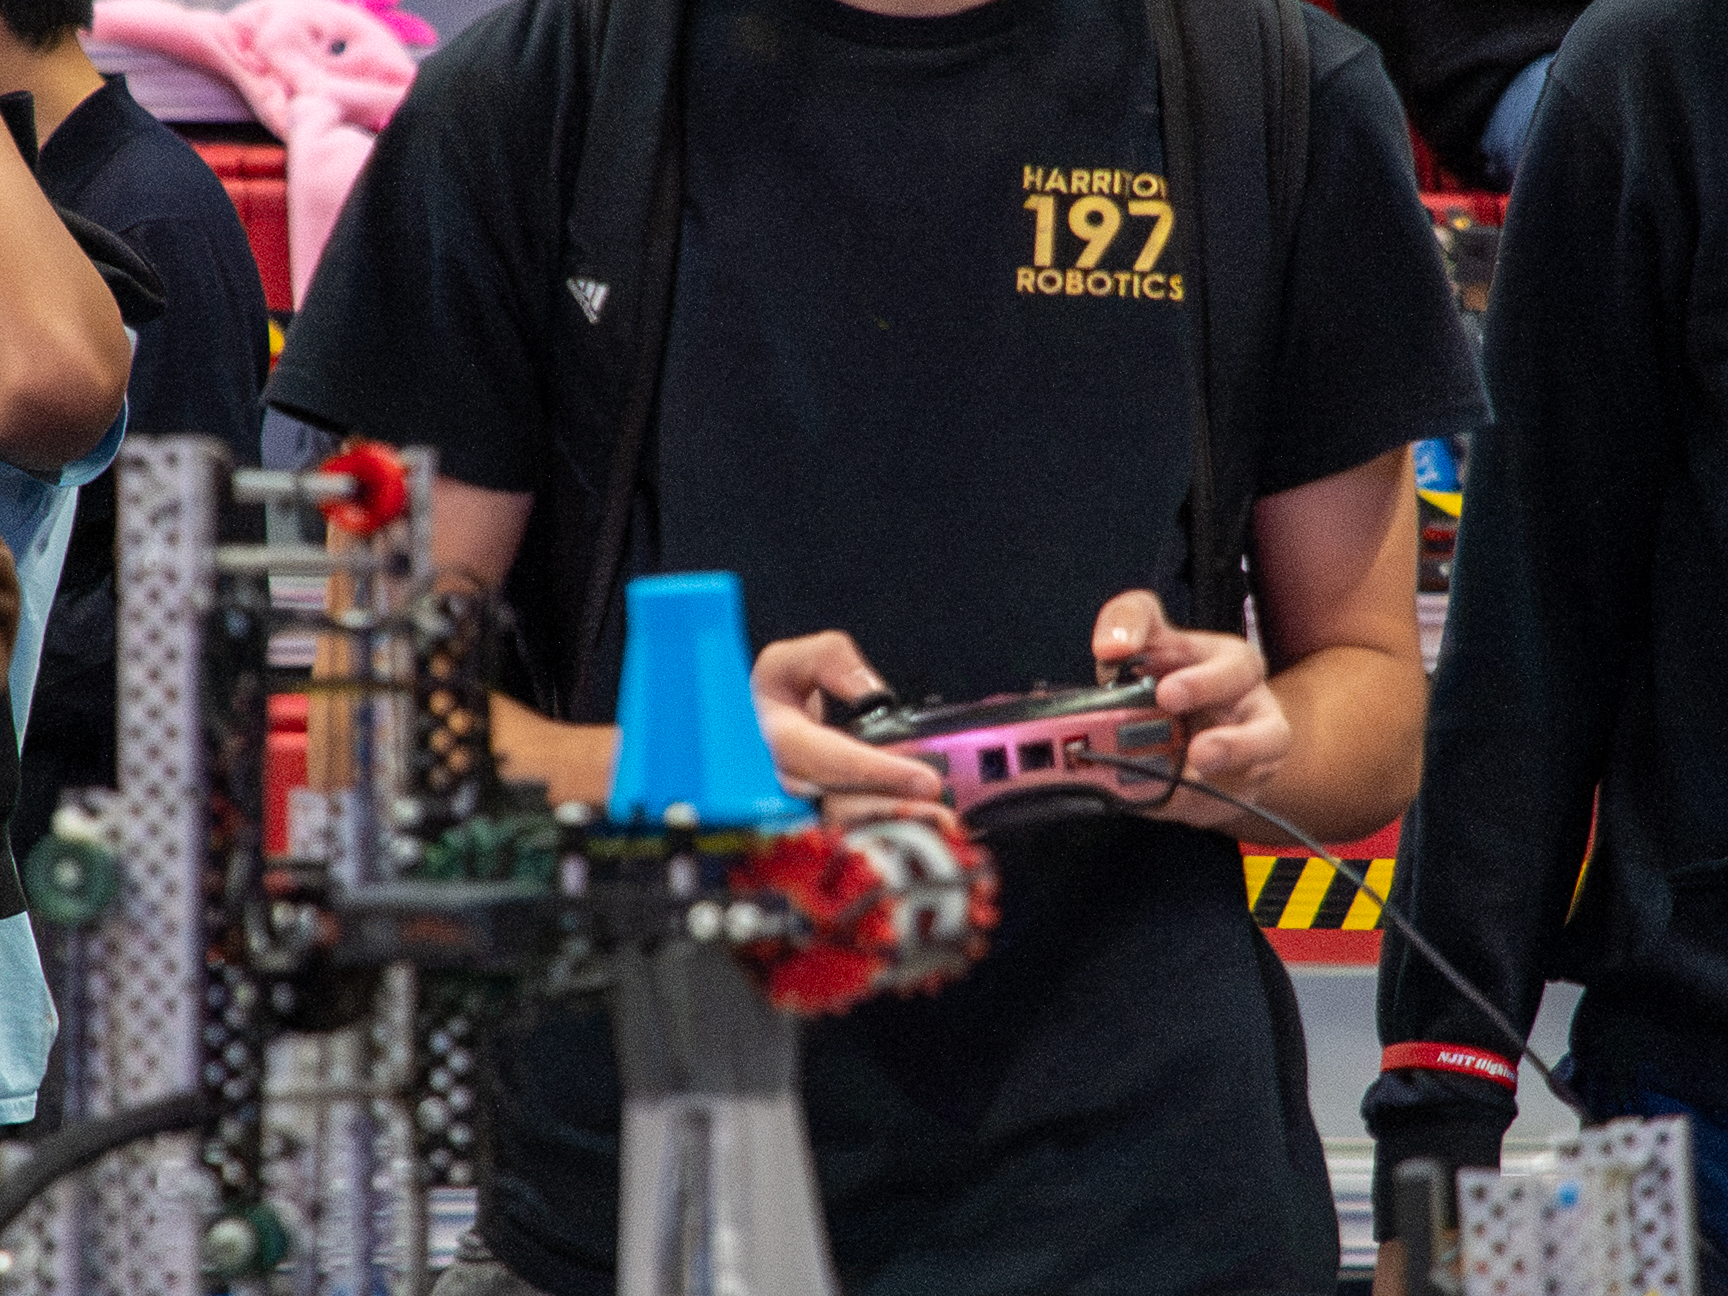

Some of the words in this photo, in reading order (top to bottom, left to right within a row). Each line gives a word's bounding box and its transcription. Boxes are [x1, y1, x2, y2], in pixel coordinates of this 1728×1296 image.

[1023, 194, 1174, 272] 197
[1016, 266, 1184, 301] ROBOTICS
[1437, 1051, 1475, 1067] NJIT
